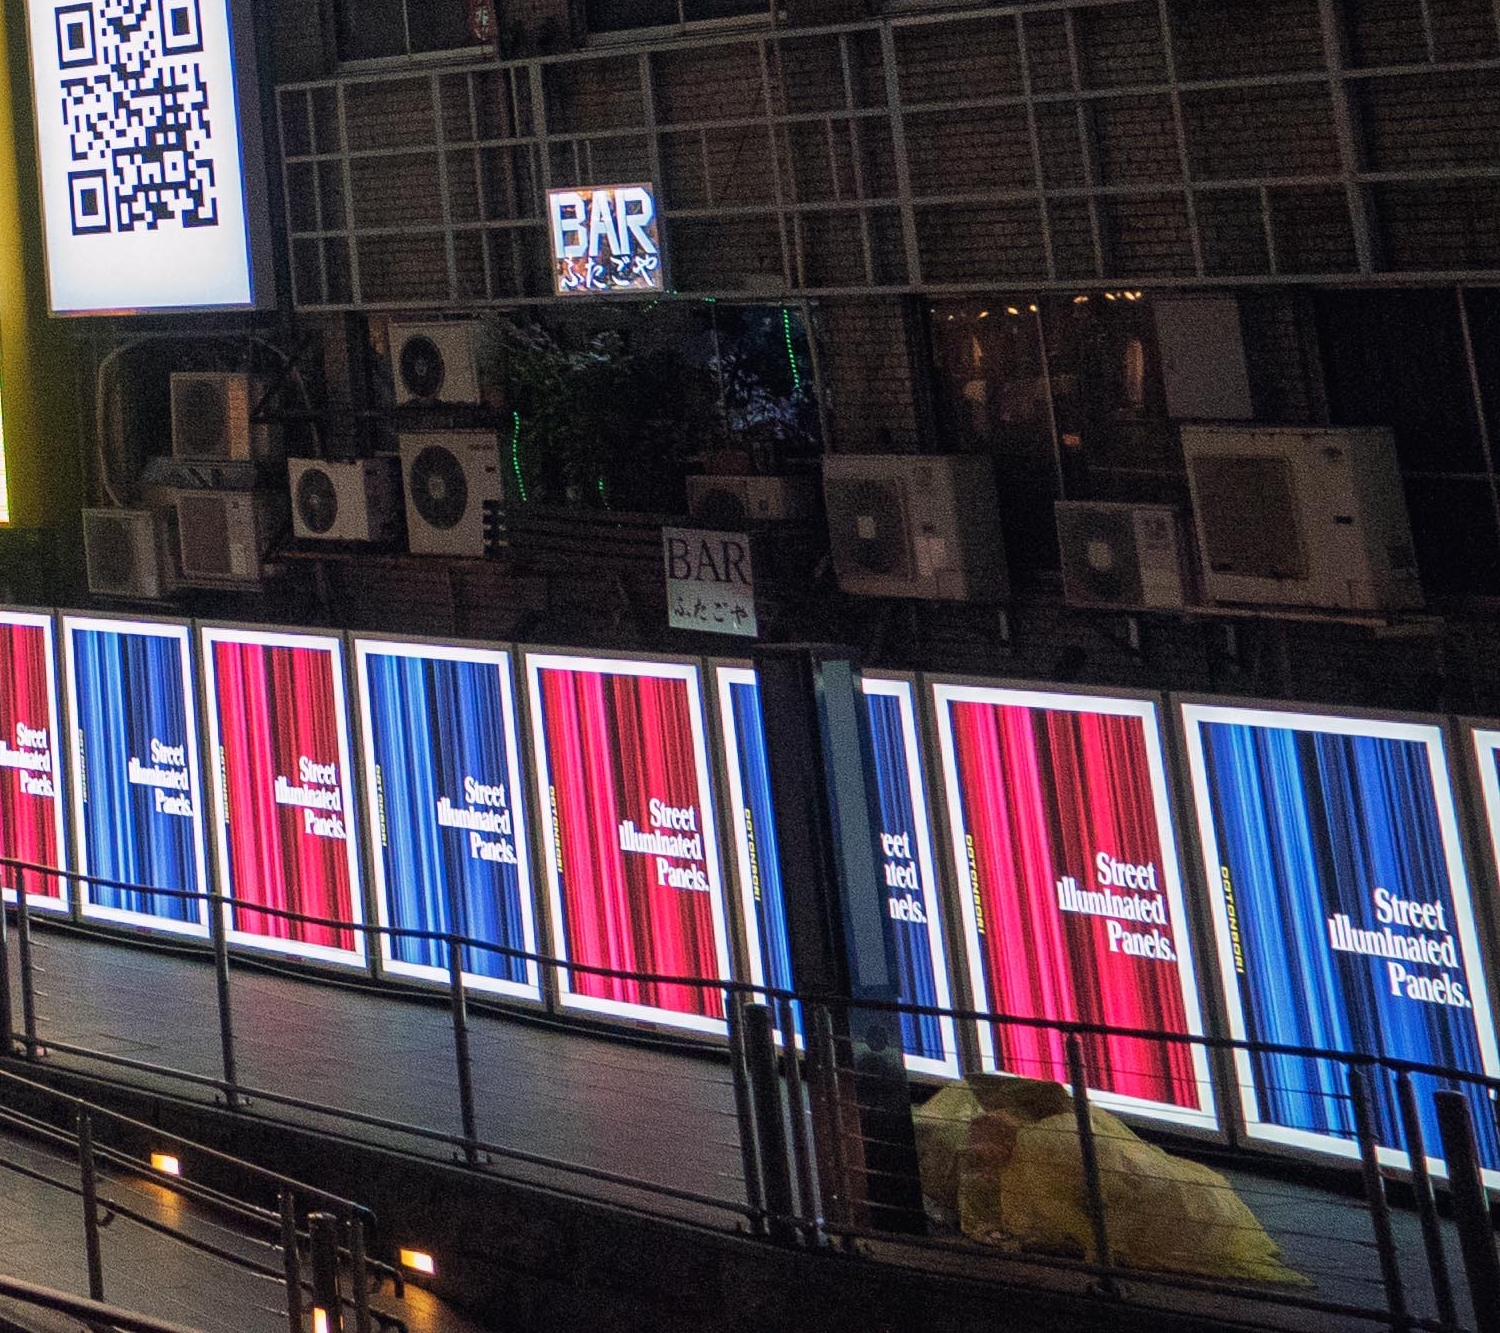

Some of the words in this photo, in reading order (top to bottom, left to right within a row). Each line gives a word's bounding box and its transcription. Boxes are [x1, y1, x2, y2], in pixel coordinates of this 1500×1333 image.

[548, 187, 657, 260] BAR
[560, 254, 659, 292] ふたごや
[666, 540, 750, 585] BAR
[673, 600, 749, 626] ふたごや
[151, 738, 184, 766] Street
[300, 755, 335, 785] Street
[464, 776, 504, 806] Street
[649, 798, 696, 830] Street
[469, 830, 517, 866] Panels.
[744, 807, 762, 902] DOTONBORI
[656, 855, 710, 892] Panels.
[965, 833, 988, 935] DOTONBORI
[1096, 852, 1157, 892] Street
[1221, 865, 1245, 975] DOTONBORI
[1375, 887, 1446, 932] Street
[1107, 920, 1177, 962] Panels.
[1388, 961, 1472, 1009] Panels.
